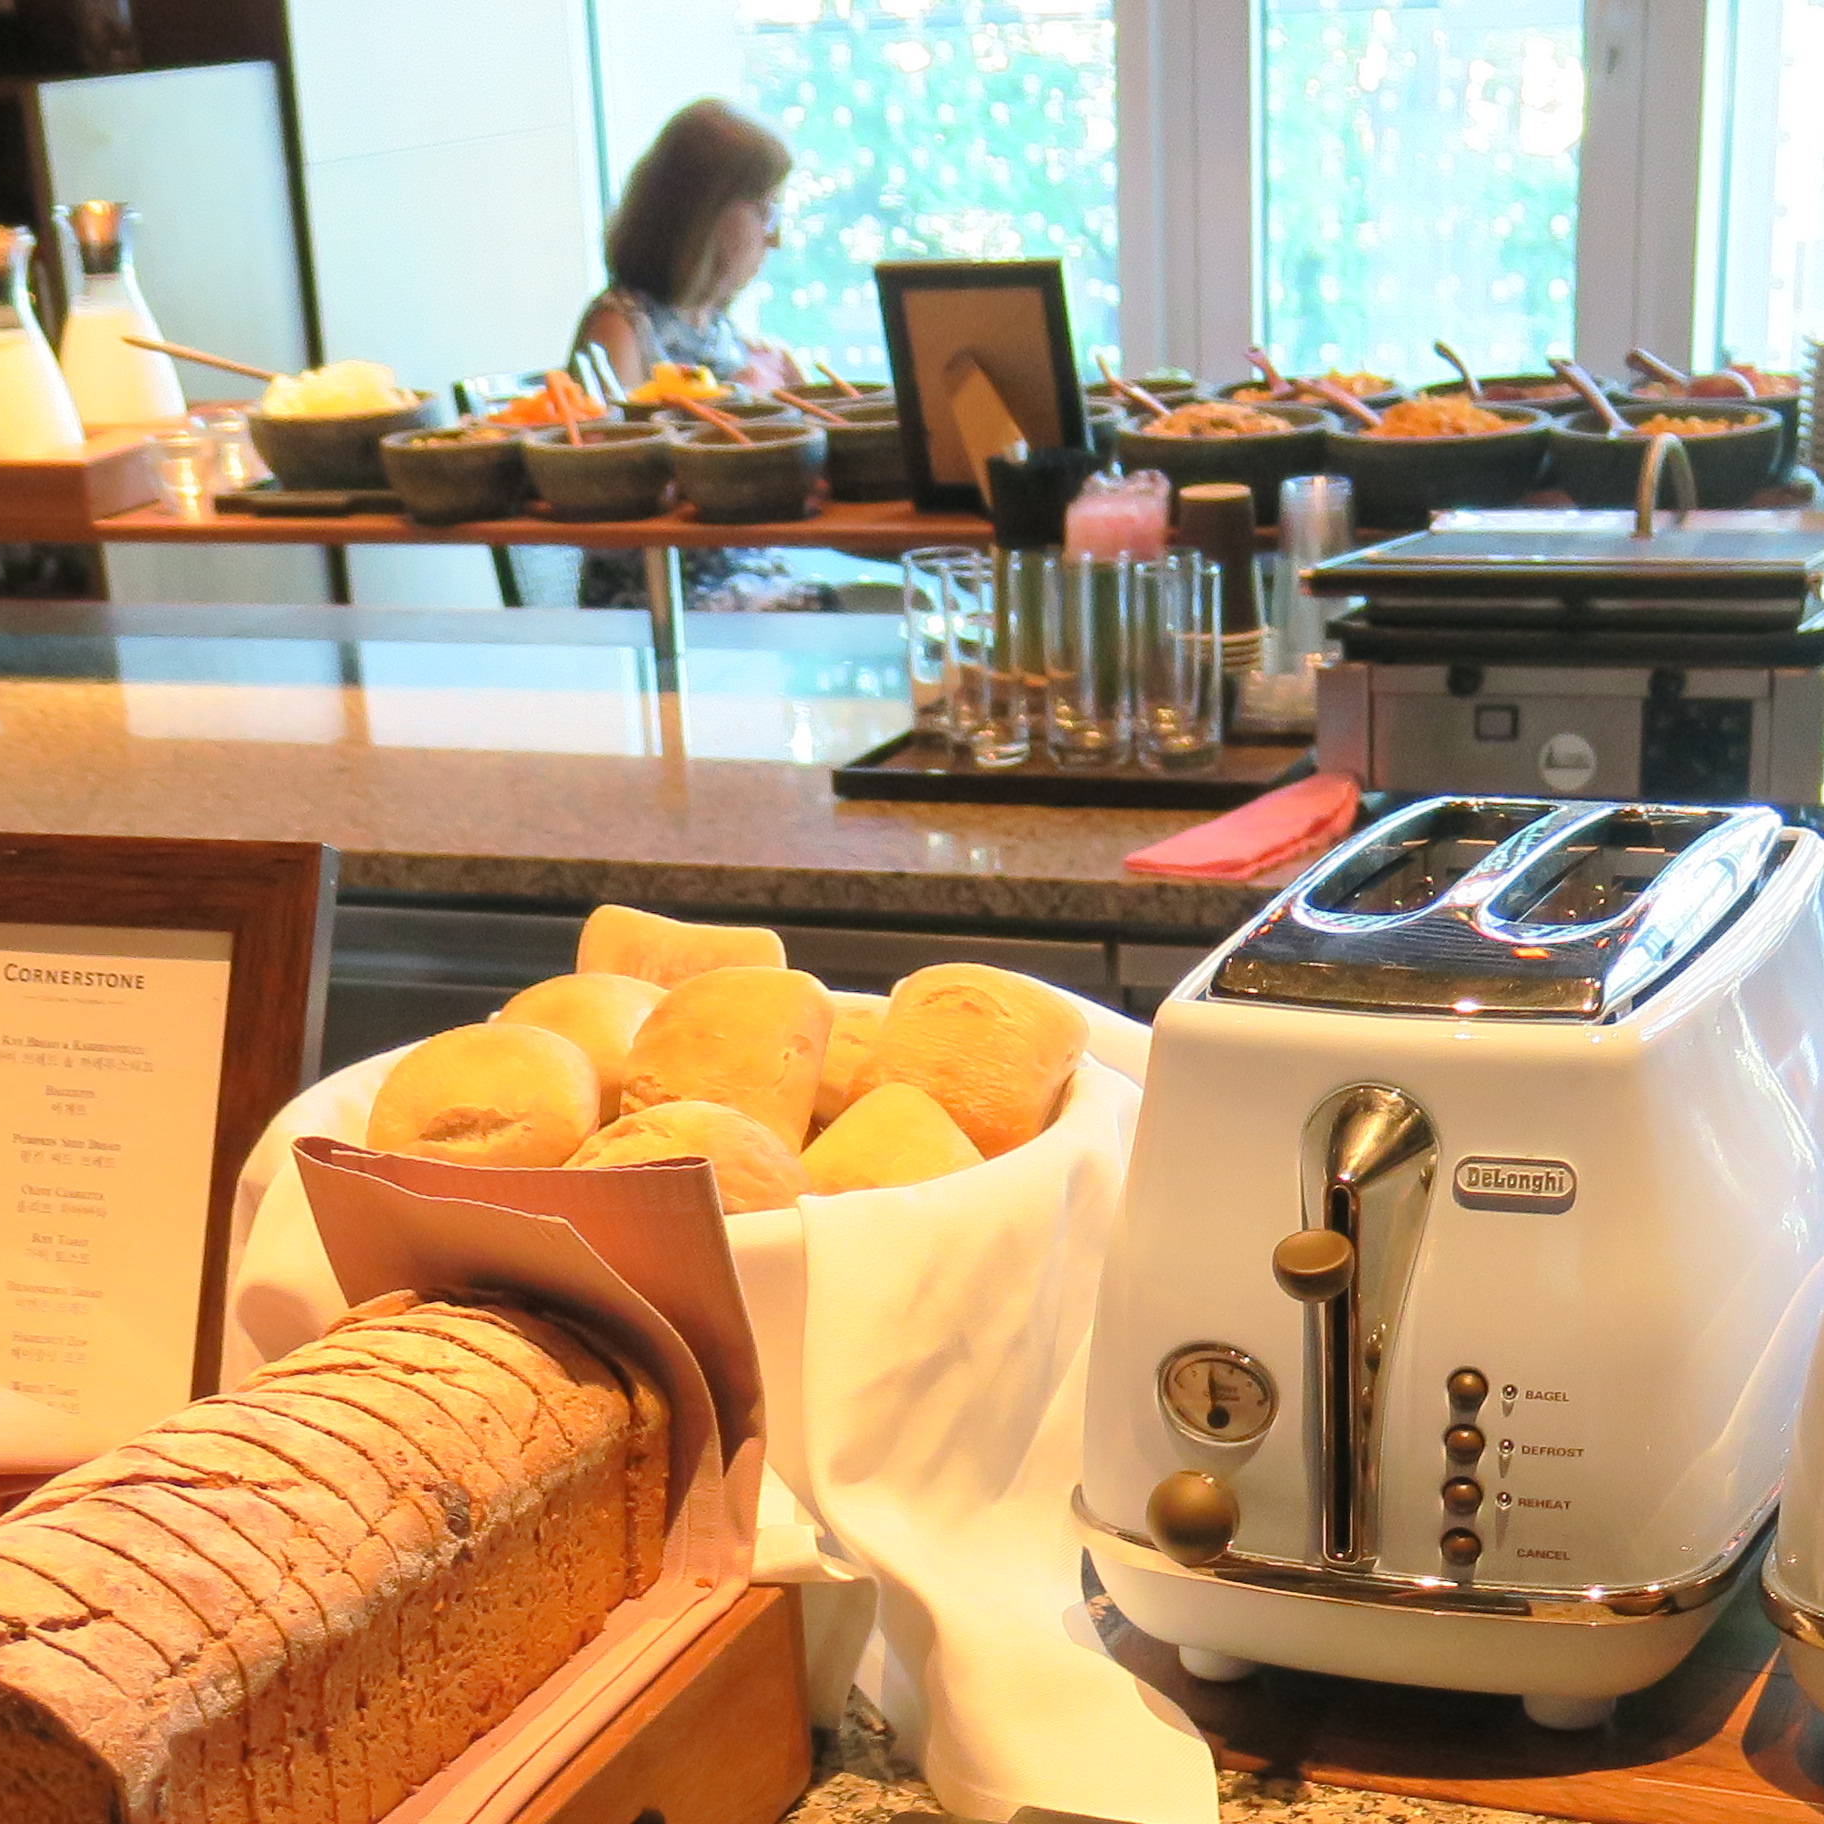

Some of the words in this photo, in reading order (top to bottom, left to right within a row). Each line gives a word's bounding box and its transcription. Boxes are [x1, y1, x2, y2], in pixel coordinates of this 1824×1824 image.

[1525, 1389, 1570, 1402] BAGEL
[1521, 1445, 1585, 1458] DEFROST
[1517, 1497, 1572, 1510] REHEAT
[1516, 1548, 1571, 1561] CANCEL
